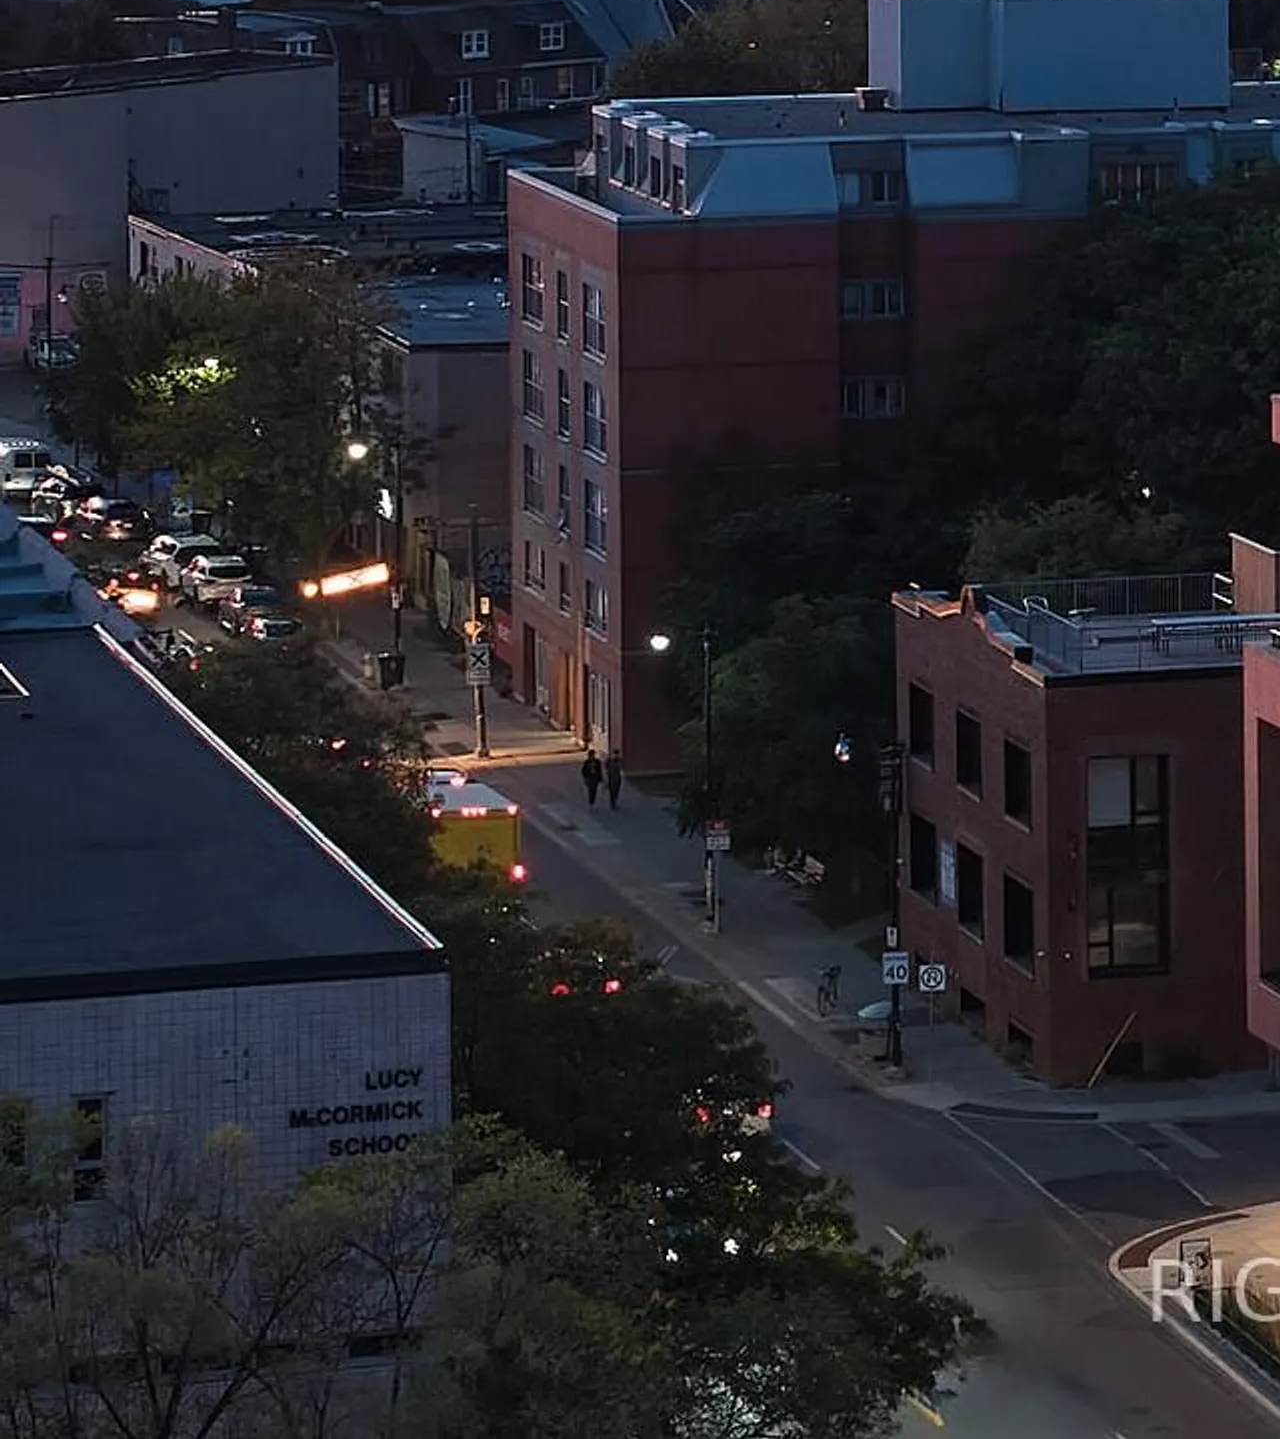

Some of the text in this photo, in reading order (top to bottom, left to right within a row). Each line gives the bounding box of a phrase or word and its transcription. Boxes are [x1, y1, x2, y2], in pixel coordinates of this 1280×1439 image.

[886, 965, 906, 979] 40
[365, 1068, 422, 1091] LUCY
[328, 1132, 417, 1158] SCHOO
